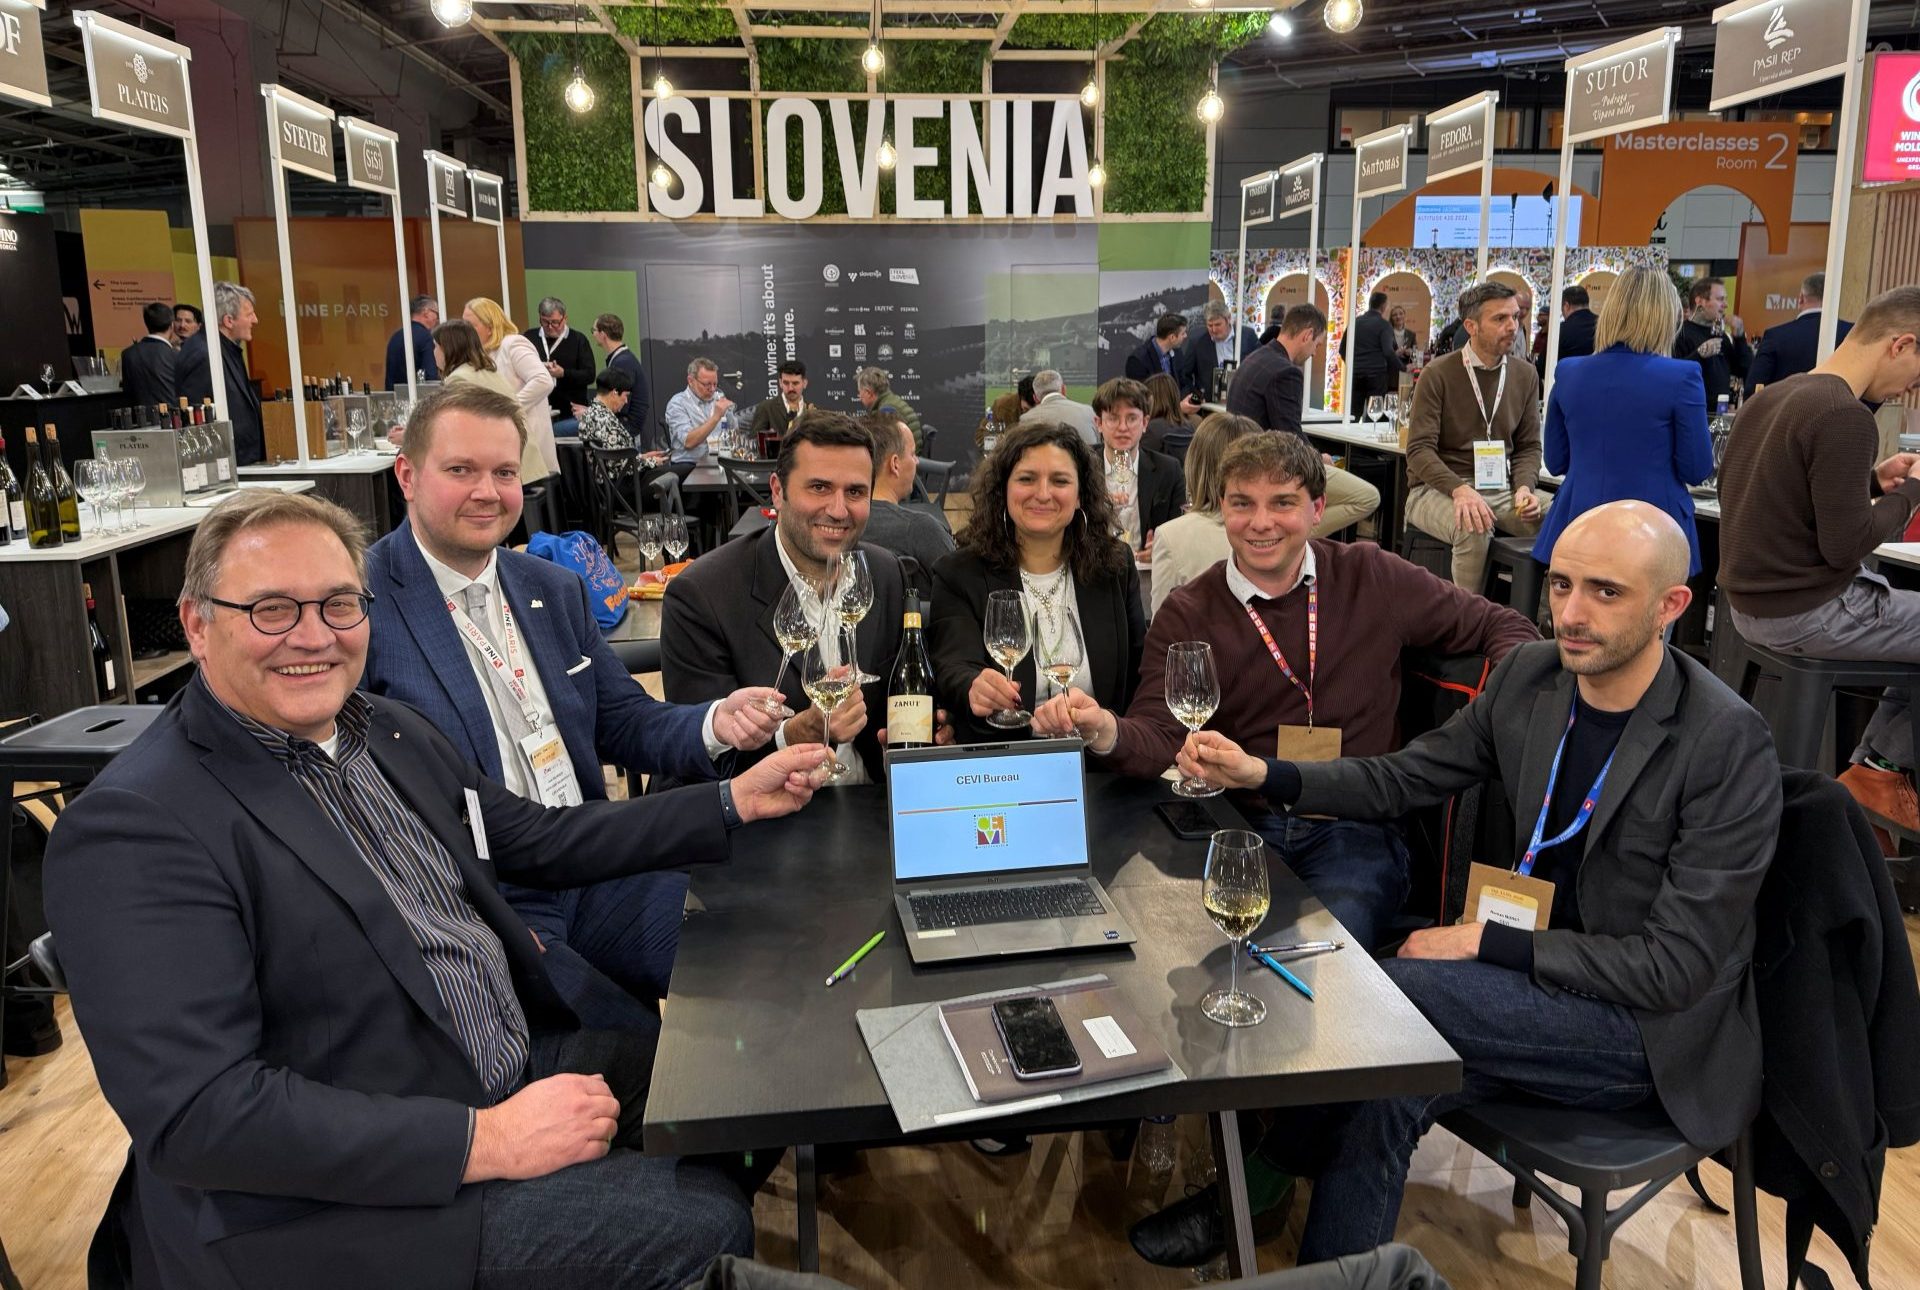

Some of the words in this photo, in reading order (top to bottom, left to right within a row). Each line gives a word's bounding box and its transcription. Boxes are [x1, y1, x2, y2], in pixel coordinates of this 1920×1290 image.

[1781, 47, 1801, 65] REP
[1585, 57, 1648, 95] SUTOR
[117, 83, 169, 115] PLATEIS
[283, 120, 329, 158] STEYER
[1440, 124, 1473, 150] FEDORA
[644, 96, 1096, 220] SLOVENIA
[1615, 132, 1760, 151] Masterclasses
[1765, 133, 1789, 170] 2
[1716, 156, 1757, 169] Room
[761, 263, 775, 309] about
[333, 303, 390, 318] PARIS
[1765, 294, 1798, 310] WIN
[763, 312, 777, 335] it's
[782, 308, 796, 361] nature.
[764, 339, 778, 376] wine:
[464, 622, 488, 647] PARIS
[506, 628, 518, 655] PARIS
[894, 700, 920, 708] ZANUT
[956, 774, 981, 785] CEVI
[983, 773, 1020, 783] Bureau
